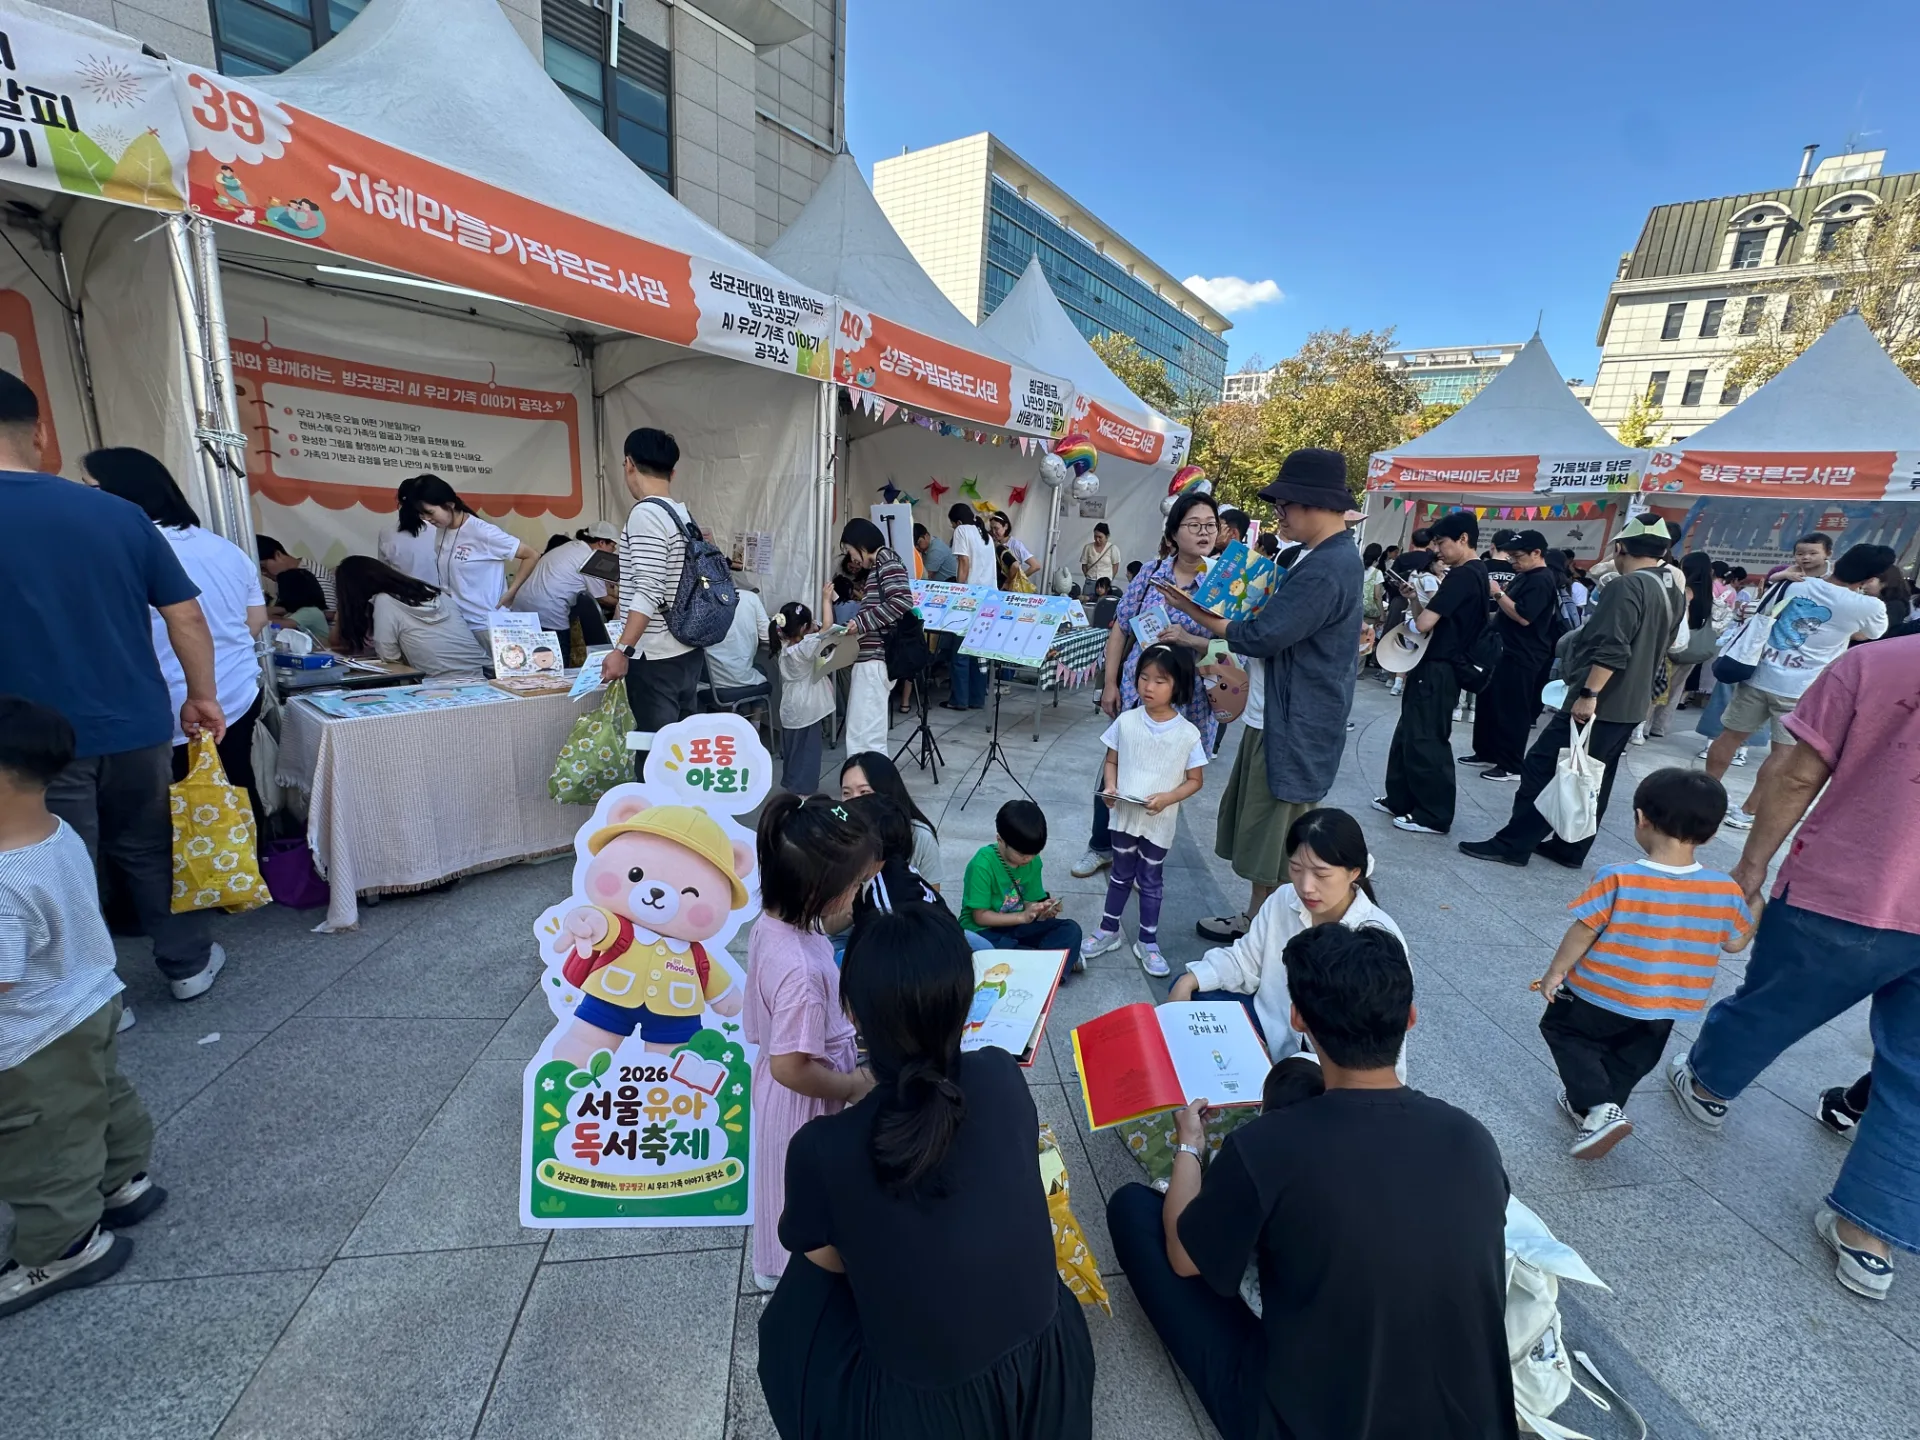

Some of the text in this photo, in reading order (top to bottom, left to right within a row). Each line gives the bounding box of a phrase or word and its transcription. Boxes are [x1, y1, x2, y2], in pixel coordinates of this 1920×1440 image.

[188, 73, 265, 145] 39
[328, 164, 671, 308] 지혜만들기작은도서관
[709, 271, 824, 317] 성균관대와 함께하는,
[748, 302, 800, 328] 방긋찡긋!
[840, 310, 863, 341] 40
[722, 312, 820, 352] AI 우리 가족 이야기
[754, 341, 789, 364] 공작소
[267, 357, 336, 385] 함께하는,
[342, 370, 404, 395] 방긋찡긋!
[408, 383, 420, 396] AI
[424, 385, 449, 401] 우리
[453, 389, 477, 405] 가족
[481, 393, 516, 410] 이야기
[880, 345, 998, 404] 성동구립금호도서관
[1022, 394, 1045, 412] 나만의
[297, 408, 314, 419] 우리
[316, 411, 341, 423] 가족은
[343, 415, 360, 425] 오늘
[361, 418, 378, 427] 어떤
[1045, 416, 1065, 433] 만들기
[301, 434, 327, 446] 완성한
[329, 439, 353, 449] 그림을
[405, 447, 420, 456] 그림
[335, 426, 351, 435] 우리
[353, 428, 377, 438] 가족의
[404, 434, 426, 445] 기분을
[304, 449, 330, 460] 가족의
[332, 452, 356, 463] 기분과
[383, 457, 399, 467] 담은
[400, 460, 422, 470] 나만의
[1371, 458, 1386, 471] 42
[1552, 459, 1632, 473] 가을빛을 담은
[1651, 453, 1673, 468] 43
[1550, 475, 1586, 487] 잠자리
[688, 735, 737, 766] 포동
[686, 766, 749, 793] 야호!
[666, 961, 695, 976] Phodong
[1188, 1011, 1216, 1022] 기분을
[1188, 1024, 1211, 1035] 말해
[619, 1066, 668, 1082] 2026
[577, 1085, 708, 1126] 서울유아
[571, 1122, 710, 1166] 독서축제
[557, 1171, 590, 1186] 성균관대와
[647, 1182, 655, 1191] AI
[656, 1180, 669, 1190] 우리
[670, 1178, 683, 1189] 가족
[684, 1176, 704, 1187] 이야기
[705, 1169, 725, 1182] 공작소
